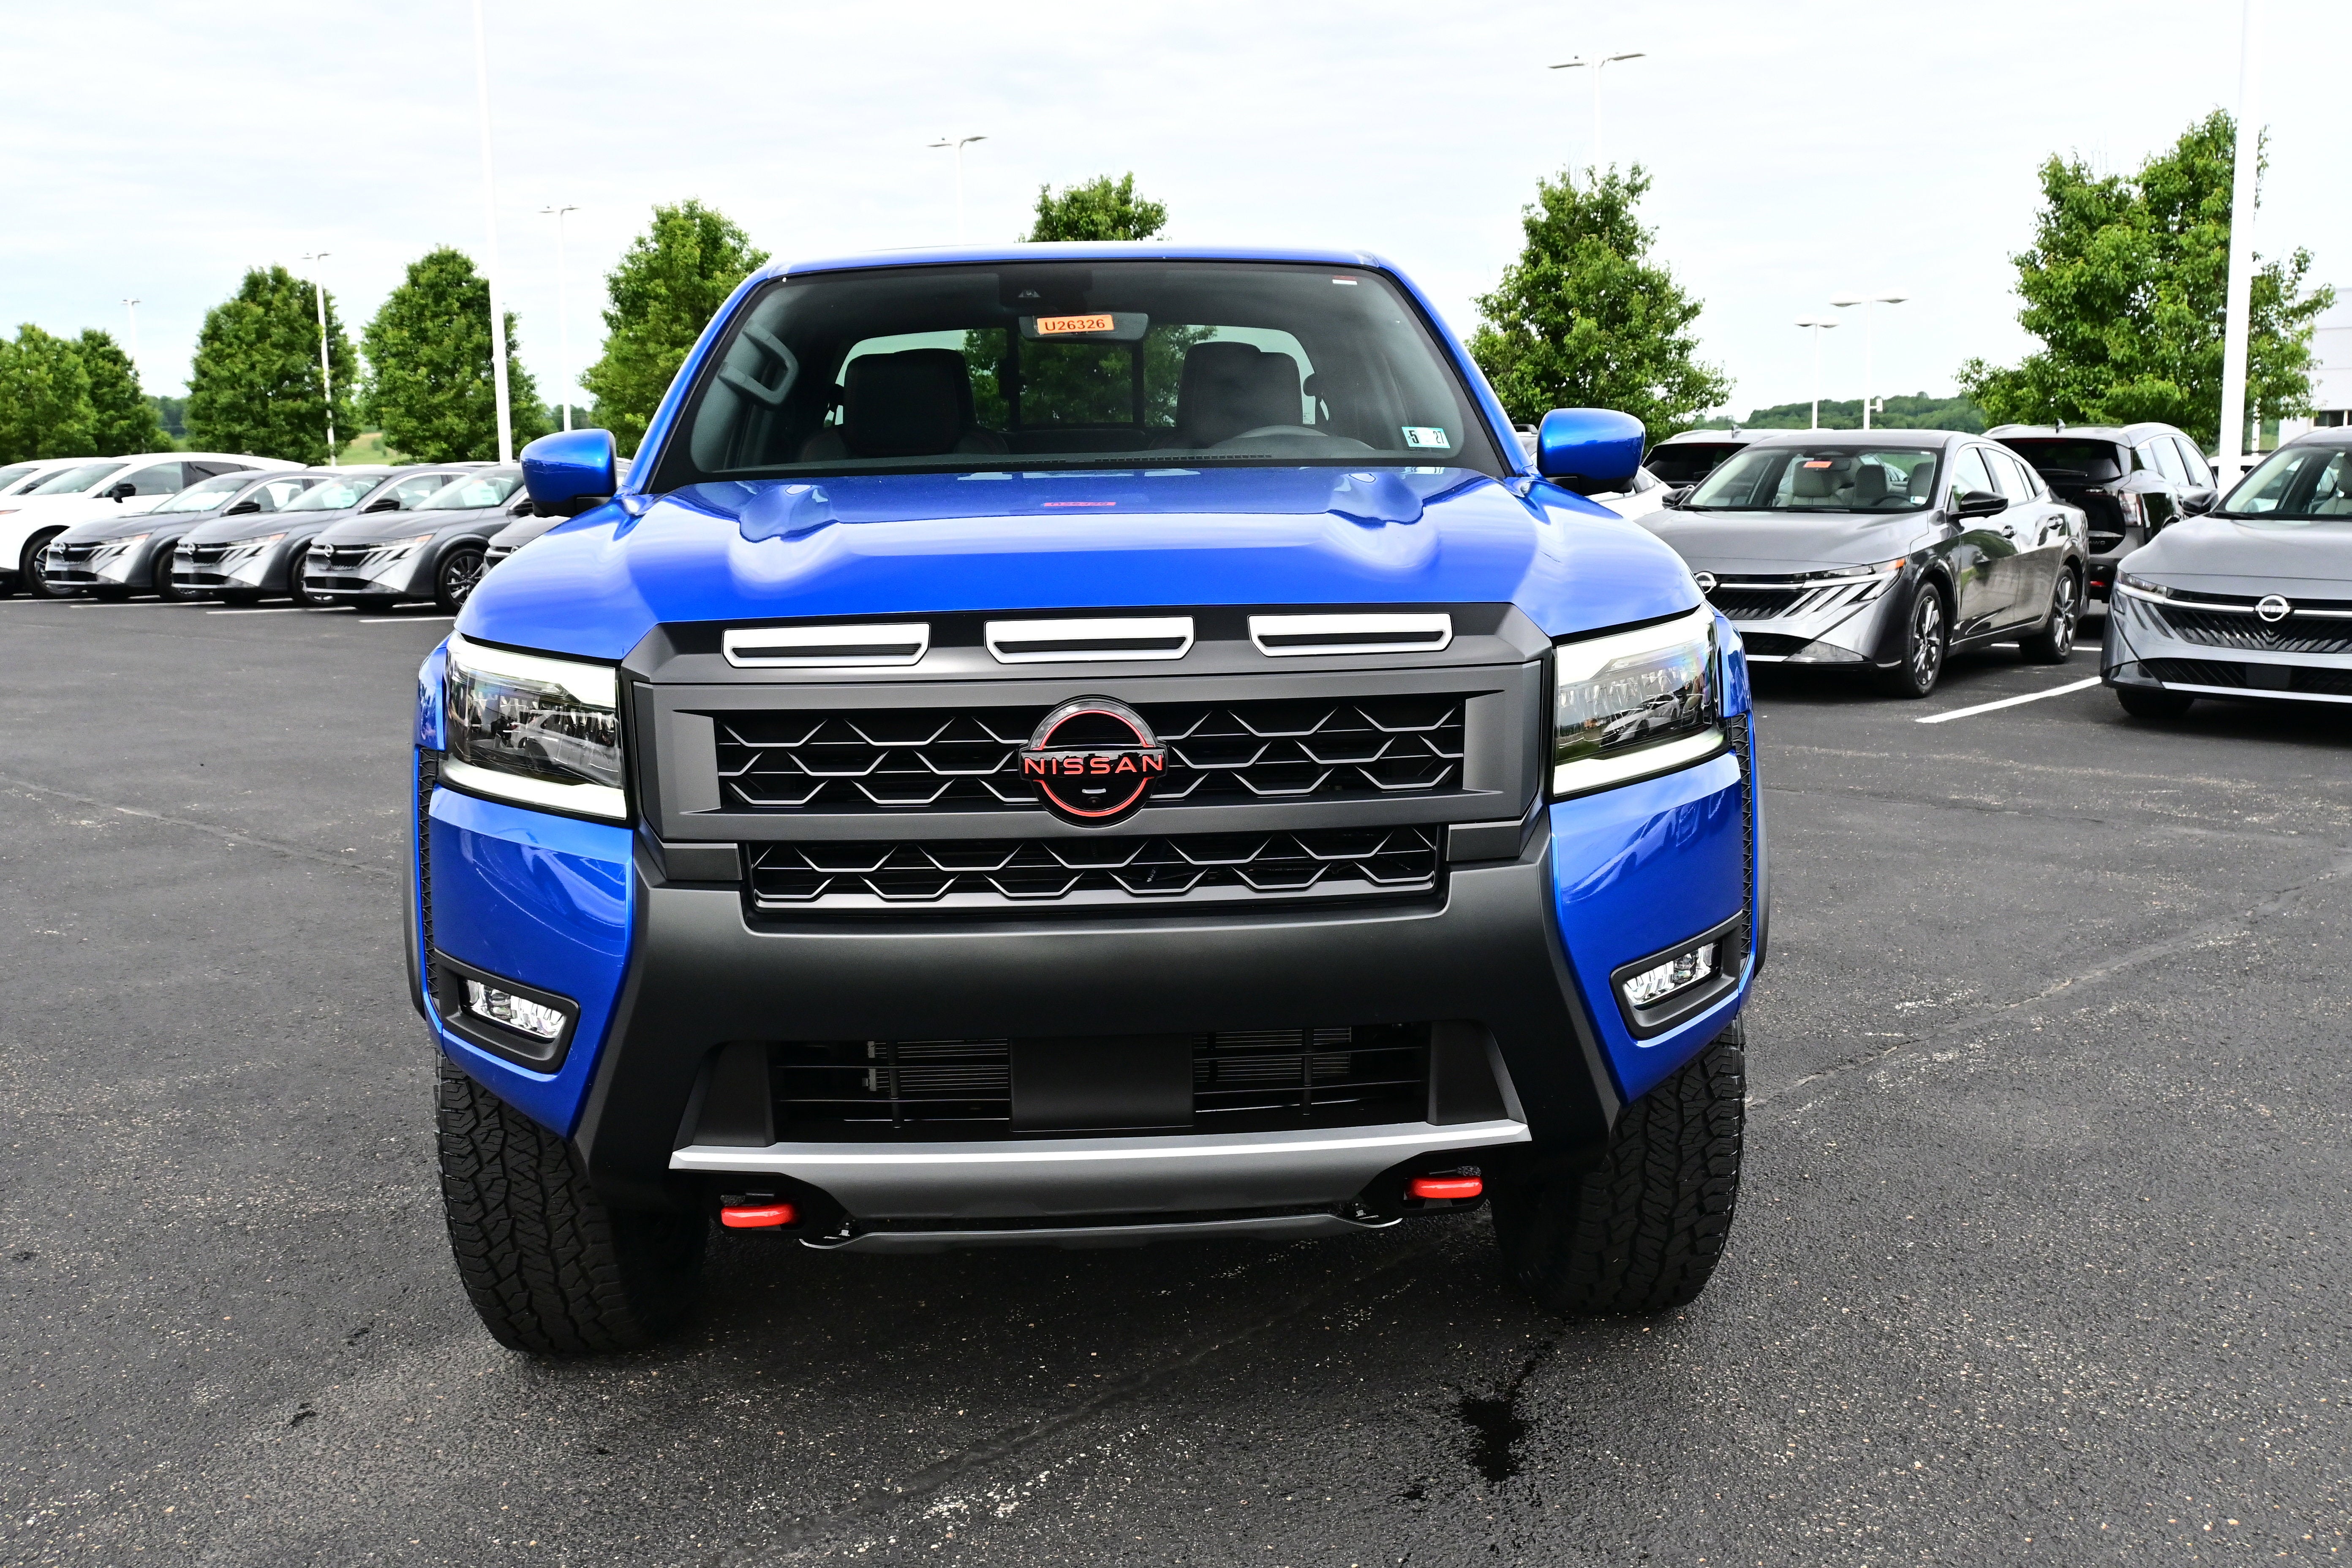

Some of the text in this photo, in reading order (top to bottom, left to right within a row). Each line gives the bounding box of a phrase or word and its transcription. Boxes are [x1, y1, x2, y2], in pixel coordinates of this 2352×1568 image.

[1045, 318, 1105, 331] U26326
[1408, 430, 1444, 444] 5 27
[1024, 754, 1163, 775] NISSAN
